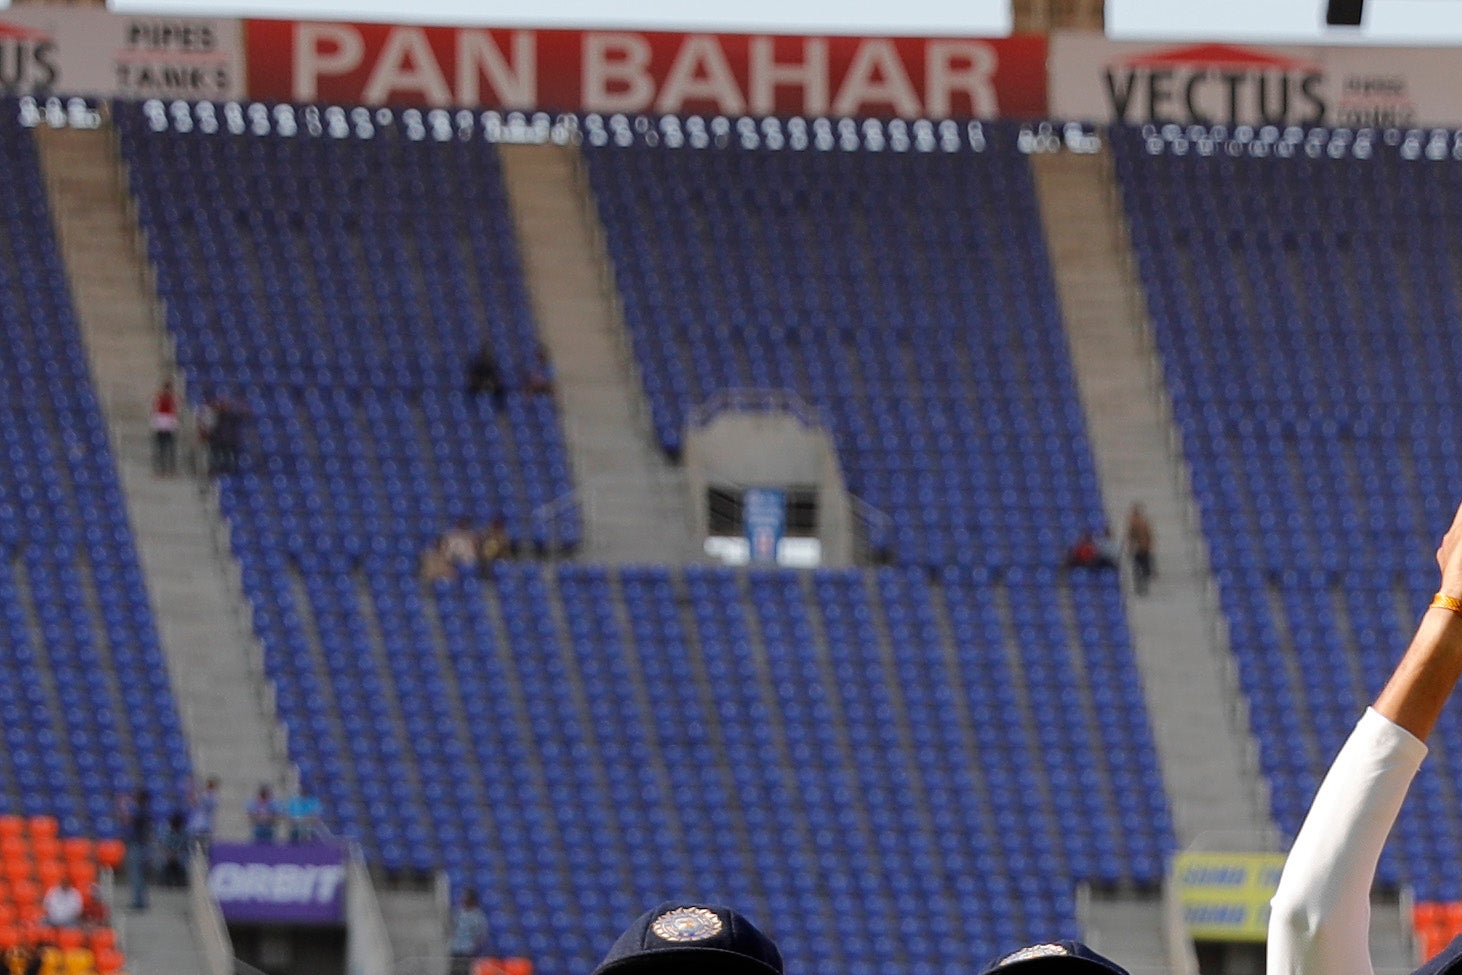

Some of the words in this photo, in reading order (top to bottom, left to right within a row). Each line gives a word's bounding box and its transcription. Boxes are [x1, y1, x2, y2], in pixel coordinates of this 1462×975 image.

[290, 21, 538, 111] PAN
[579, 29, 1004, 118] BAHAR
[1104, 67, 1327, 126] VECTUS
